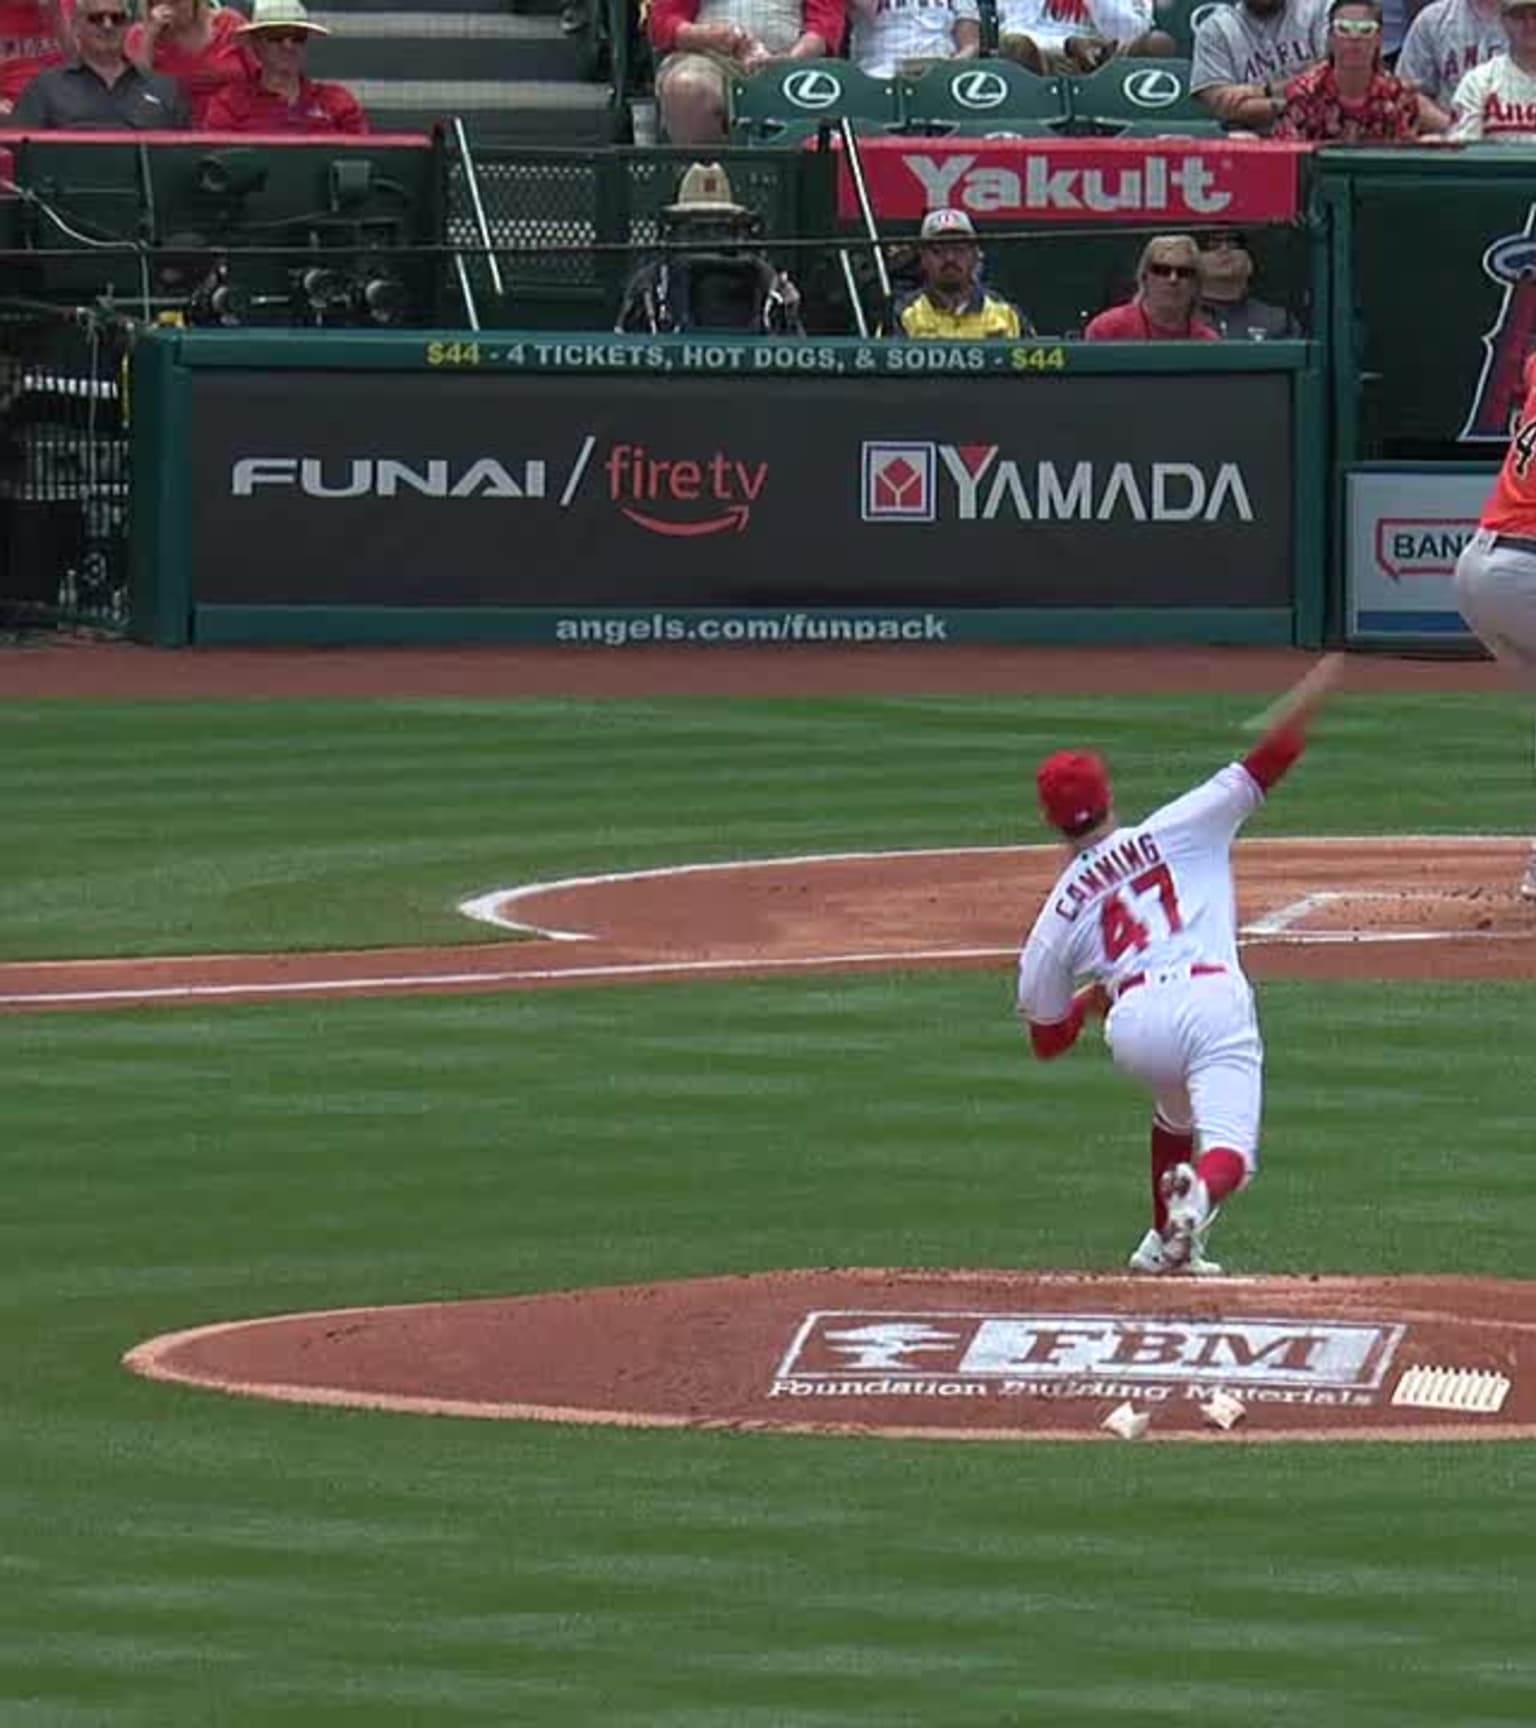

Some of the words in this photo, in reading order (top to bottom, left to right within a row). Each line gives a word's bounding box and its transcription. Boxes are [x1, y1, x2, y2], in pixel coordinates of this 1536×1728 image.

[902, 154, 1232, 213] Yakult
[427, 342, 480, 365] $44
[507, 344, 525, 365] 4
[535, 344, 673, 370] TICKETS,
[684, 345, 745, 367] HOT
[755, 347, 844, 372] DOGS,
[855, 347, 876, 369] &
[886, 348, 985, 370] SODAS
[1011, 347, 1065, 370] $44
[231, 457, 546, 499] FUNAI
[938, 444, 1254, 522] YAMADA
[555, 613, 948, 645] angels.com/funpack
[1055, 832, 1162, 923] CANNING
[1101, 863, 1183, 963] 47
[1009, 1329, 1329, 1371] FBM
[767, 1378, 988, 1399] Foundation
